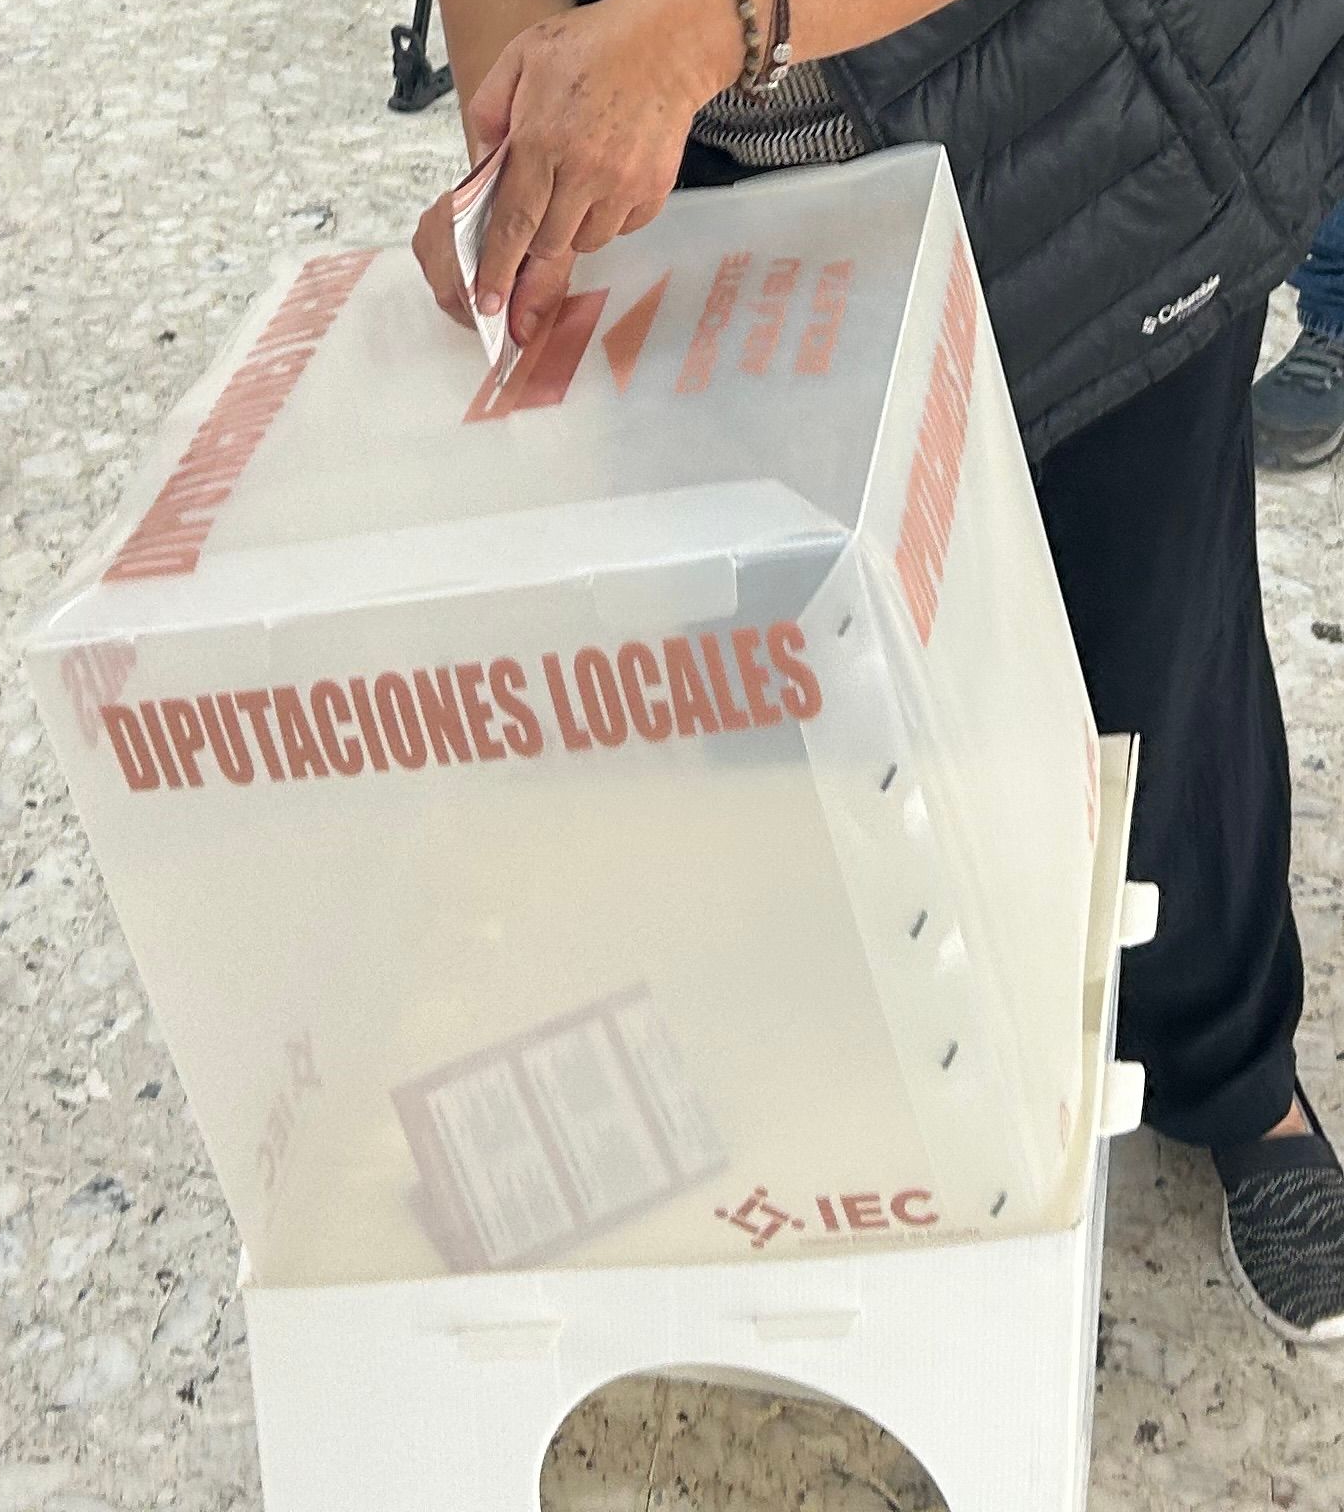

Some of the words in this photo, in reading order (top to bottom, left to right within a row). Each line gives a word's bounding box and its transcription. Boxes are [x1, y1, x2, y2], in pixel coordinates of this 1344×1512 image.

[101, 659, 542, 790] DIPUTACIONES
[544, 622, 822, 750] LOCALES
[815, 1188, 939, 1232] IEC
